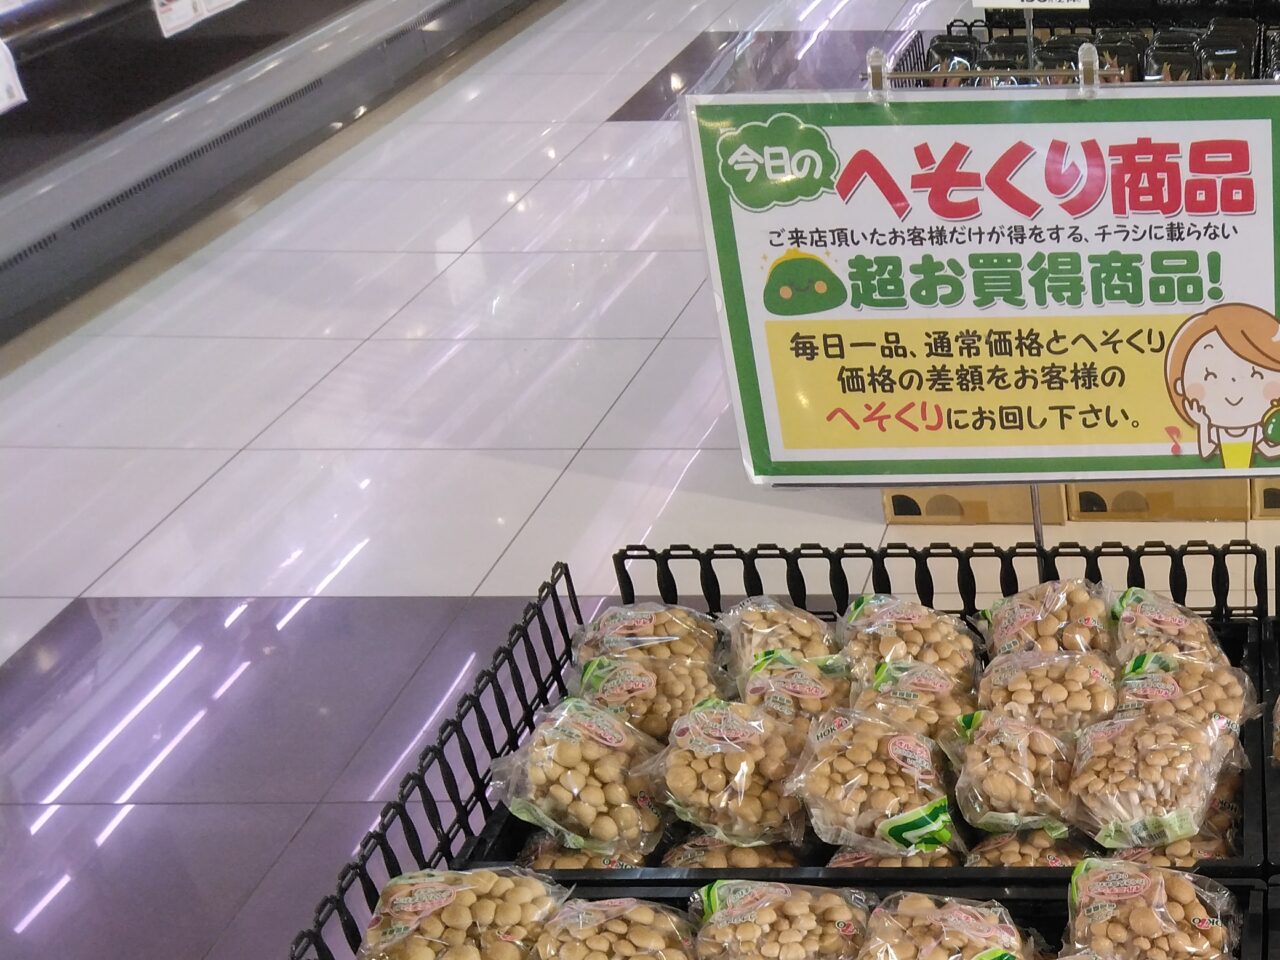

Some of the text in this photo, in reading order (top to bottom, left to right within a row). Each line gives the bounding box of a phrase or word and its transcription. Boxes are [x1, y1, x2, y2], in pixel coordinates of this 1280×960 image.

[727, 145, 824, 181] 今日の
[834, 137, 1256, 220] へそくり商品
[836, 362, 1125, 392] 価格の差額をお客様の
